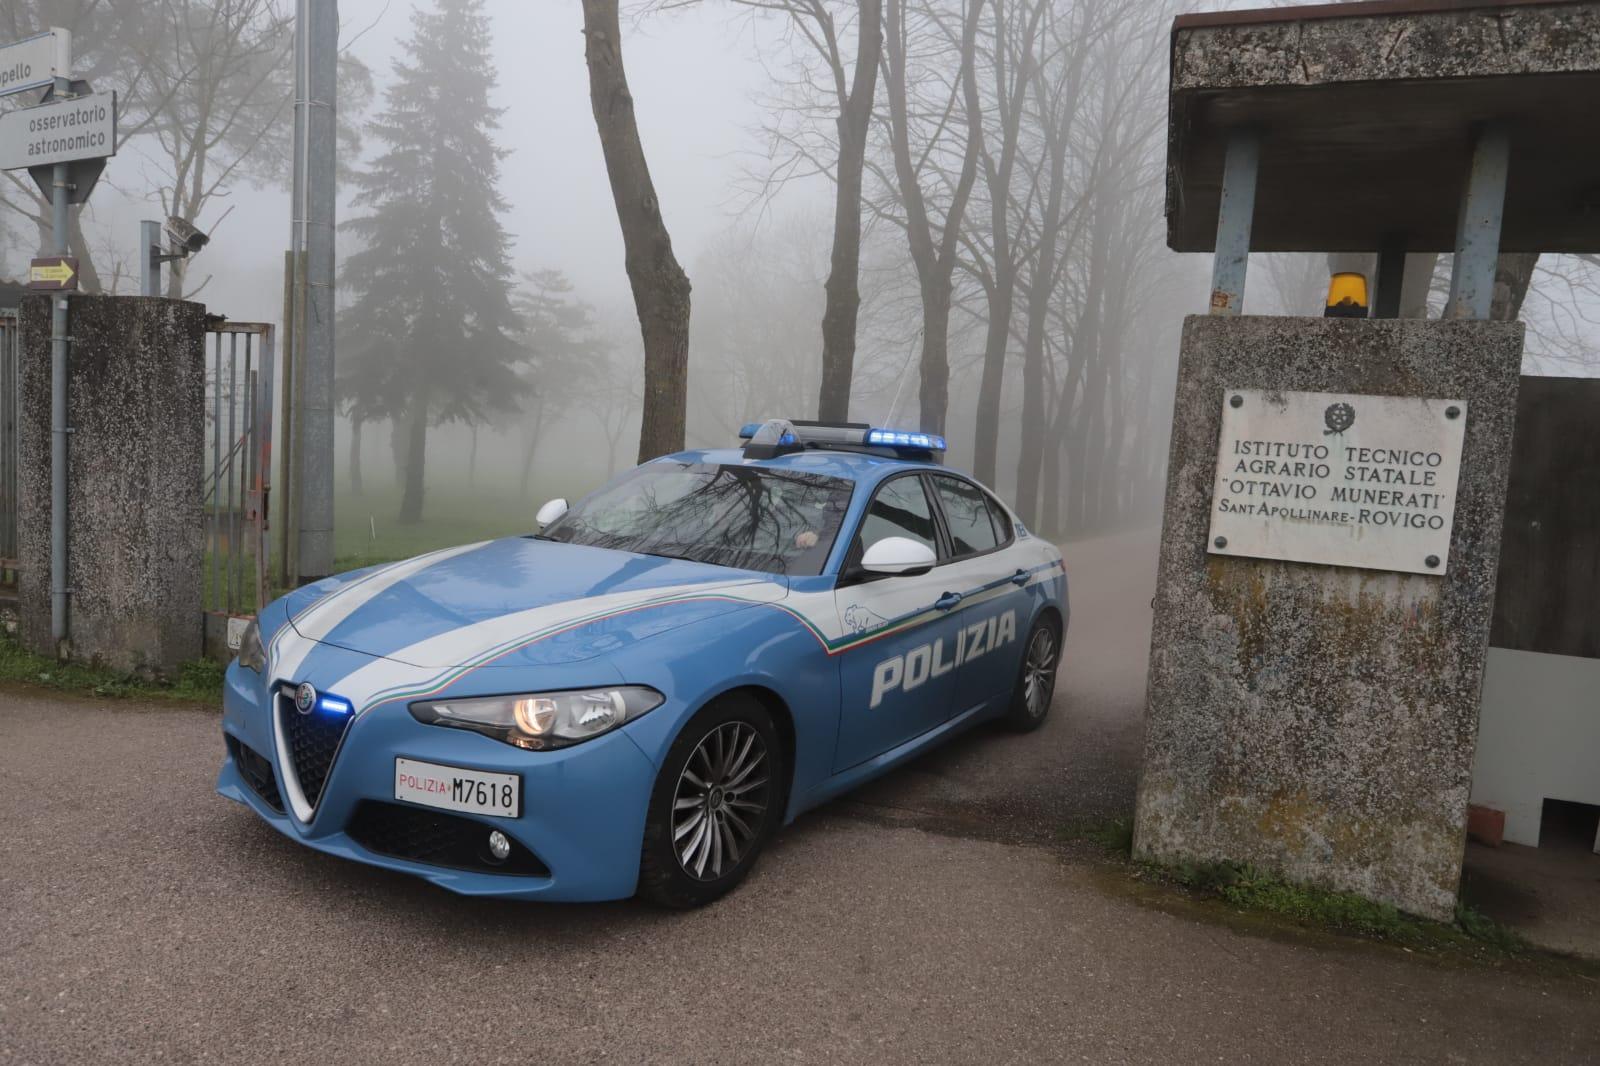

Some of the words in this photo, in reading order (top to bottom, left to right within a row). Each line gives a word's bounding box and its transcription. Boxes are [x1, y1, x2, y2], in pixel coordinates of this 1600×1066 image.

[0, 62, 31, 87] pello
[29, 105, 106, 133] osservatorio
[27, 131, 105, 156] astronomico
[1234, 440, 1329, 460] ISTITUTO
[1345, 447, 1442, 467] TECNICO
[1235, 459, 1330, 479] AGRARIO
[1344, 466, 1436, 487] STATALE
[870, 609, 1016, 710] POLIZIA
[399, 774, 446, 793] POLIZIA
[452, 778, 513, 808] M7618
